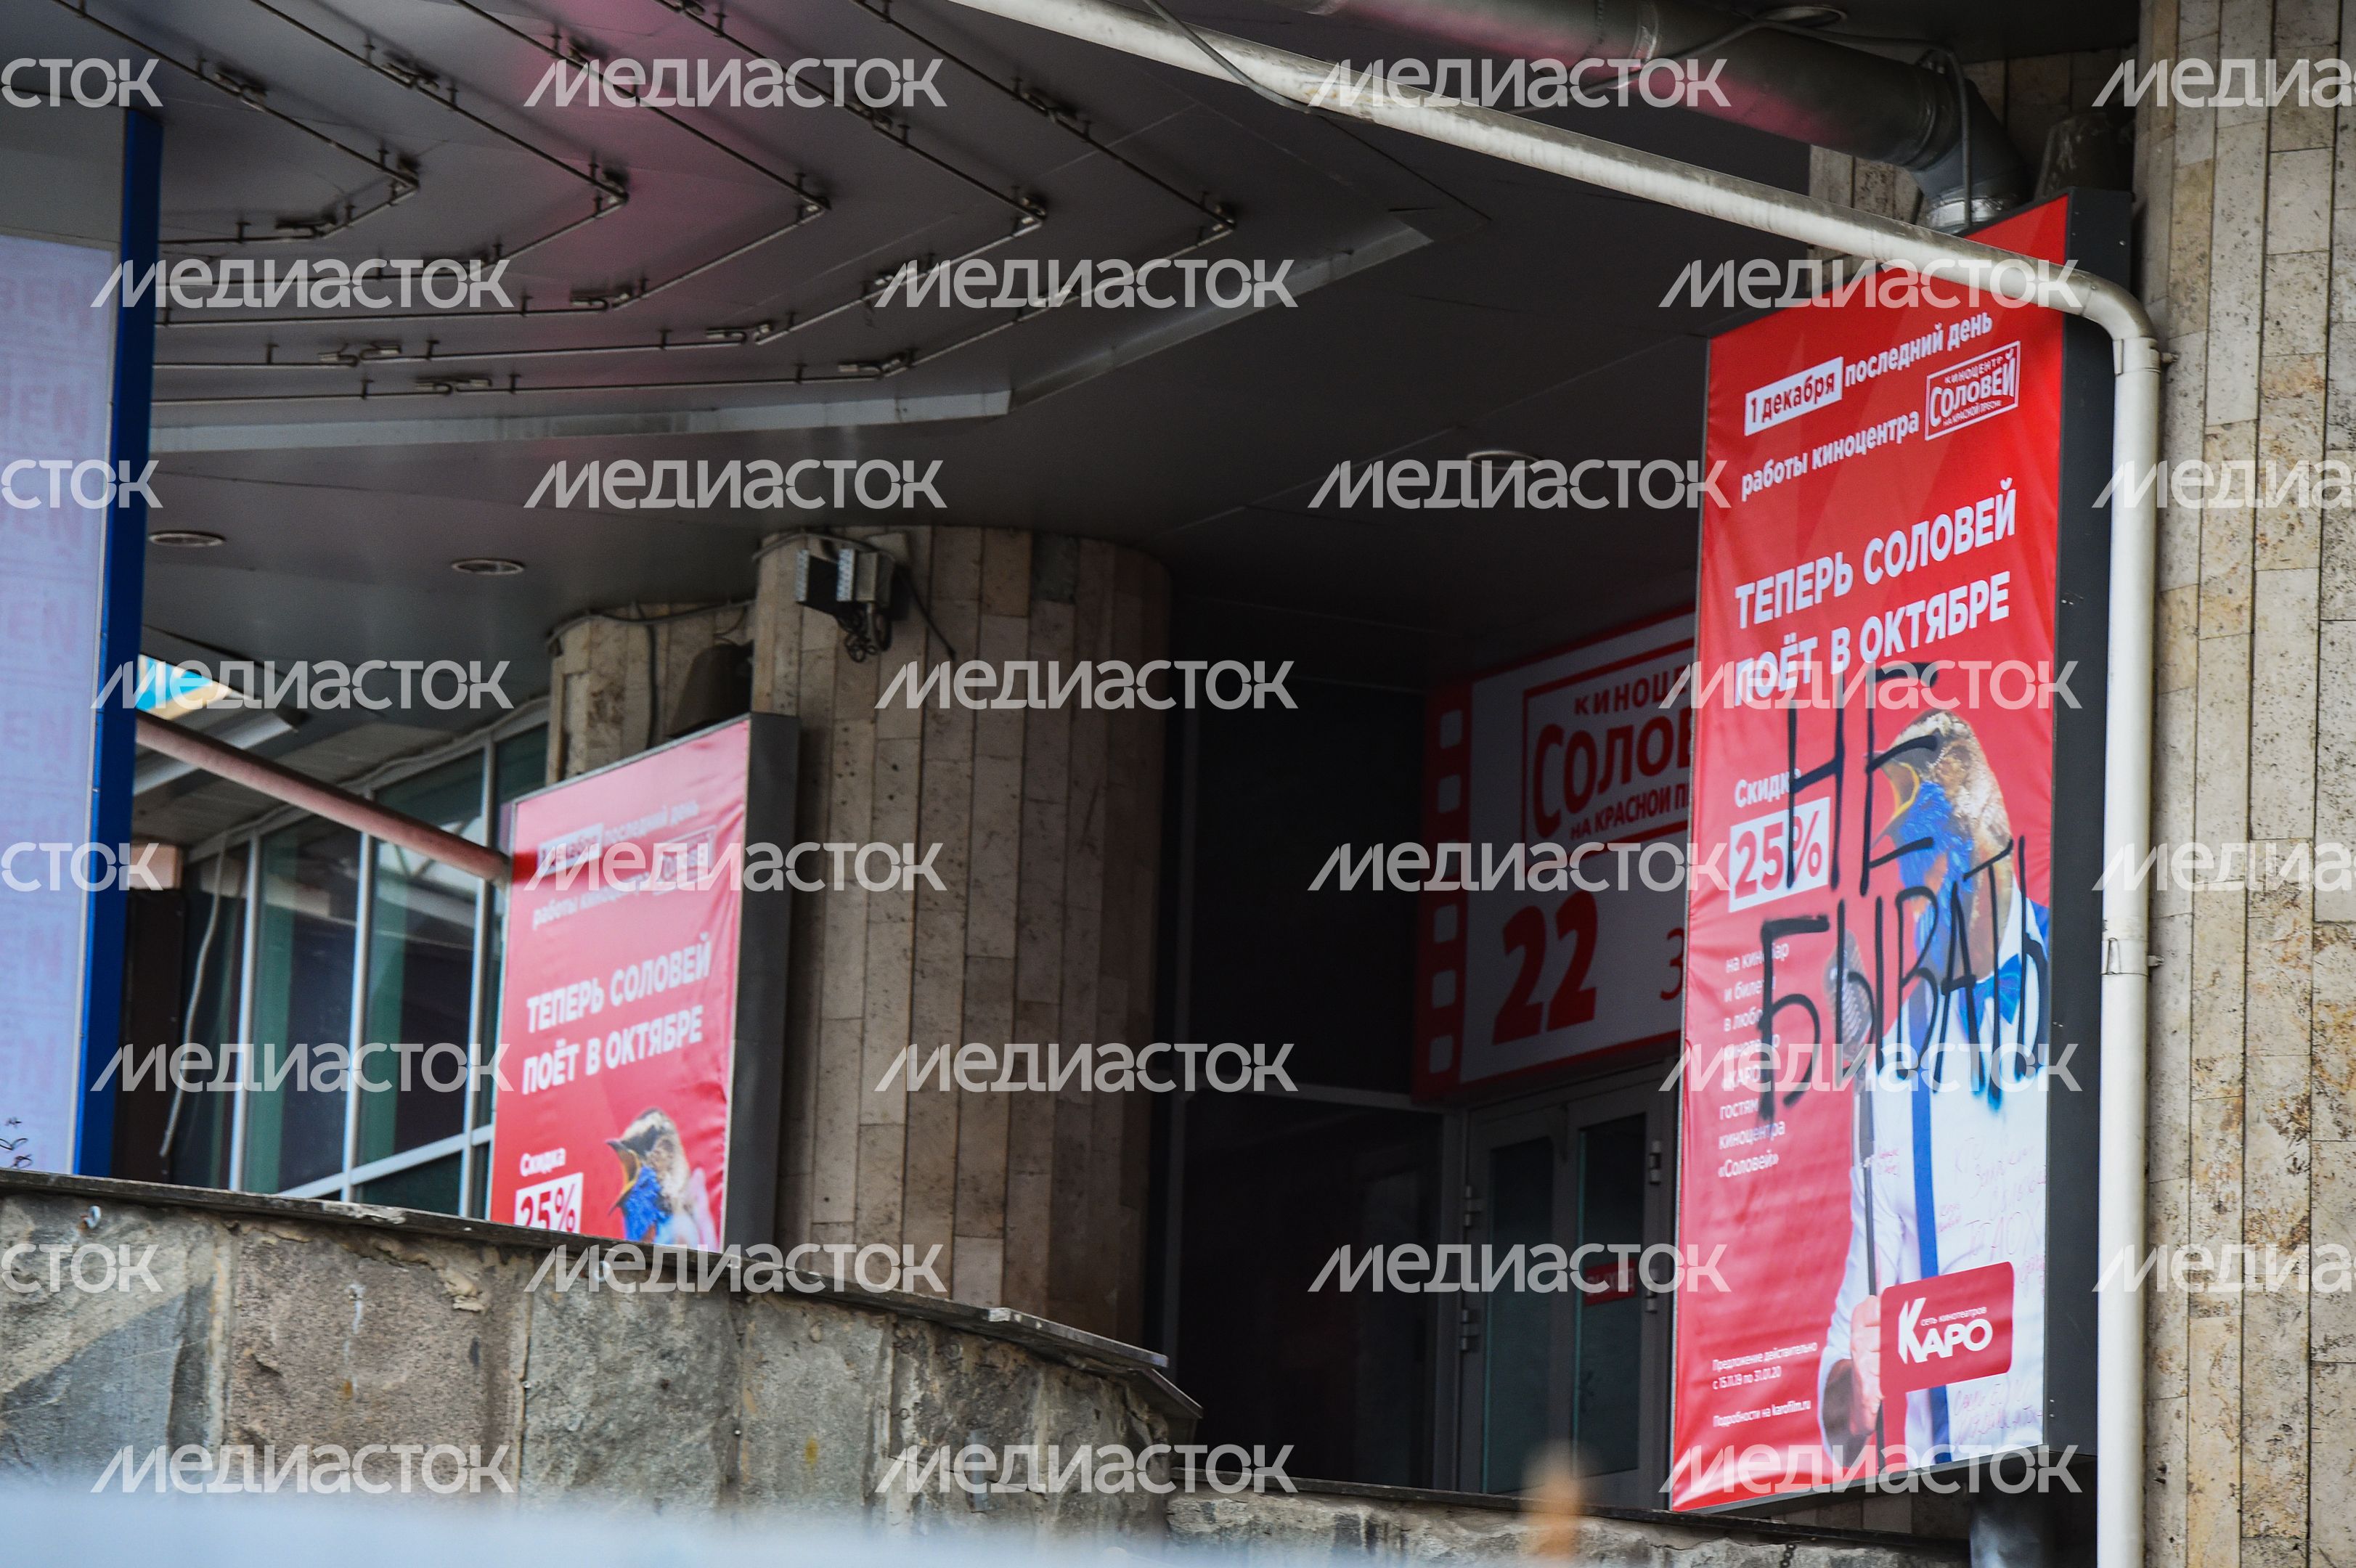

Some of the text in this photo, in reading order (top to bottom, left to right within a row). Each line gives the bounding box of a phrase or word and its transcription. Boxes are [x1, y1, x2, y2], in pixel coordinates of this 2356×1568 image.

[1750, 311, 1993, 423] 1 декабря последний день
[1930, 348, 2015, 427] СОЛОВЕЙ
[1742, 411, 1919, 502] работы киноцентра
[1735, 477, 2017, 629] ТЕПЕРЬ СОЛОВЕЙ
[1734, 571, 2010, 706] ПОЁТ В ОКТЯБРЕ
[1786, 661, 1938, 897] НЕ
[1570, 817, 1592, 840] НА
[1735, 810, 1820, 899] 25%
[527, 932, 712, 1034] ТЕПЕРЬ СОЛОВЕЙ
[1492, 891, 1597, 1045] 22
[522, 1005, 704, 1095] ПОЁТ В ОКТЯБРЕ
[1719, 1120, 1786, 1150] киноцентра
[1898, 1297, 1993, 1365] КАРО
